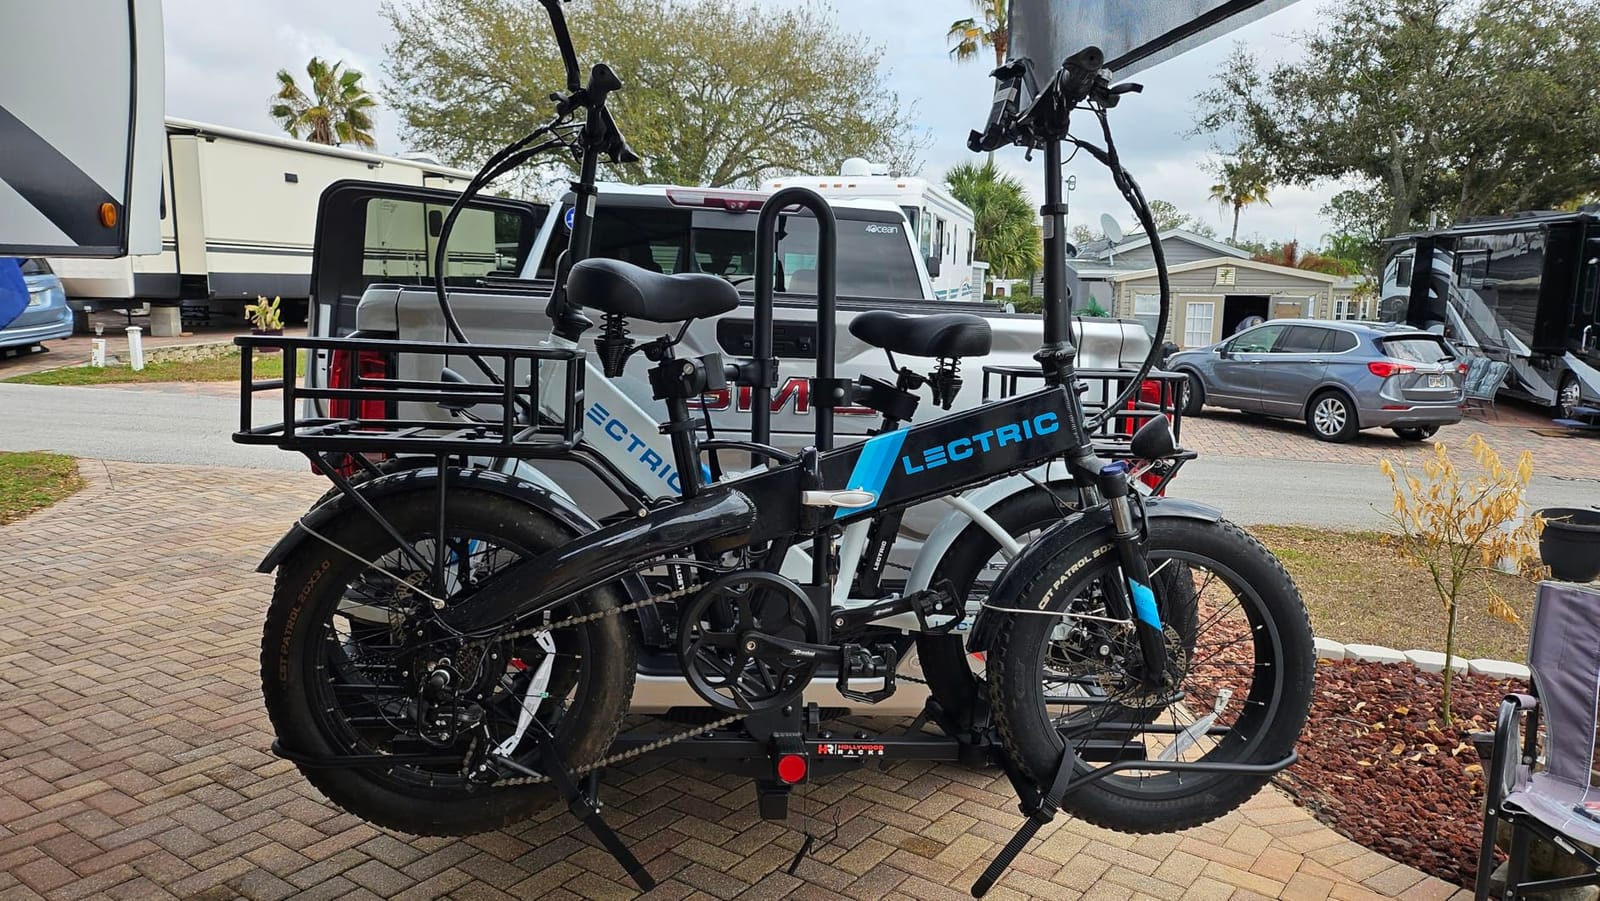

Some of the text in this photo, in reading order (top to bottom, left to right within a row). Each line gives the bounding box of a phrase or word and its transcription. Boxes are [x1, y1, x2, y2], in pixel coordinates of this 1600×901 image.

[586, 402, 682, 494] ECTRIC
[902, 411, 1060, 476] LECTRIC
[873, 540, 887, 571] LECTRIC
[1038, 587, 1054, 610] CST
[1053, 556, 1093, 590] PATROL
[280, 604, 302, 655] PATROL
